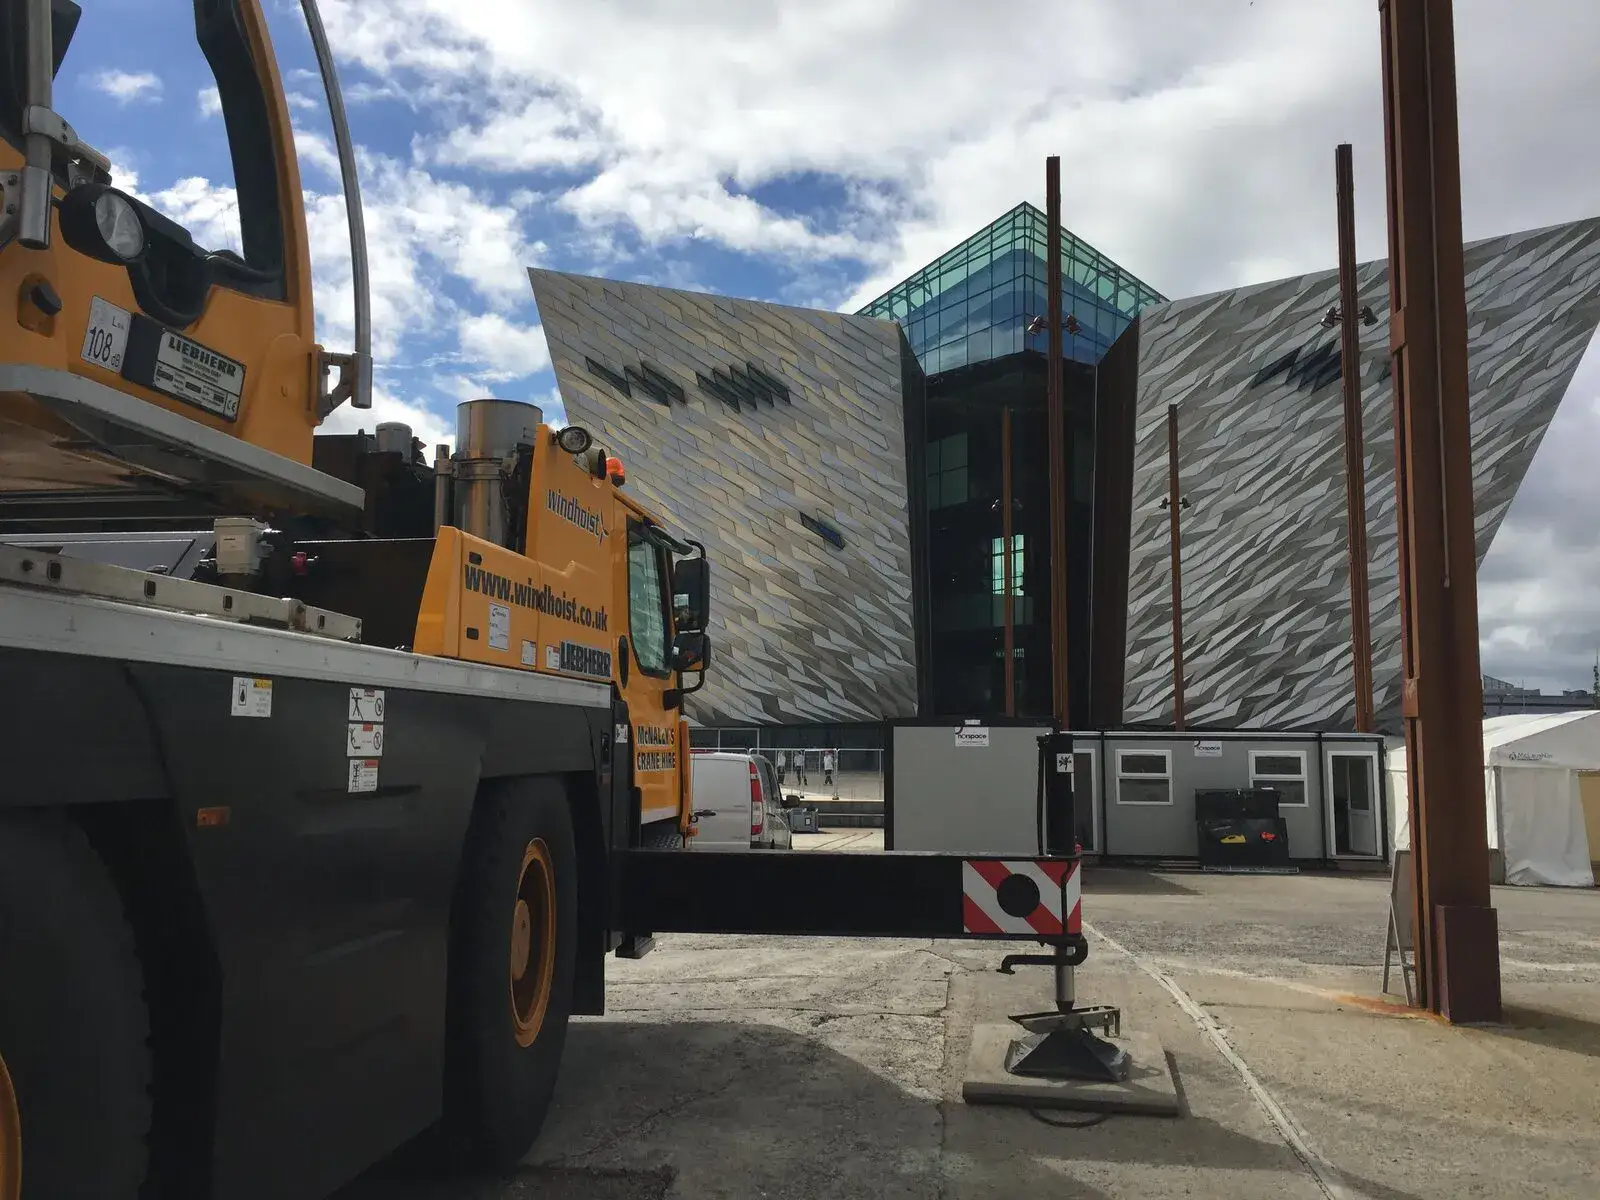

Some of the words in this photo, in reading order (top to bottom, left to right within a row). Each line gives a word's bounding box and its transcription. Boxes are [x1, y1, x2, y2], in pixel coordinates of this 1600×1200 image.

[87, 326, 113, 363] 108
[111, 353, 121, 368] dB
[168, 335, 237, 377] LIEBHERR
[547, 488, 600, 538] windhoist
[464, 563, 608, 632] www.windhoist.co.uk
[560, 641, 612, 678] LIEBHERR
[637, 752, 660, 771] CRANE
[661, 752, 676, 769] HIRE
